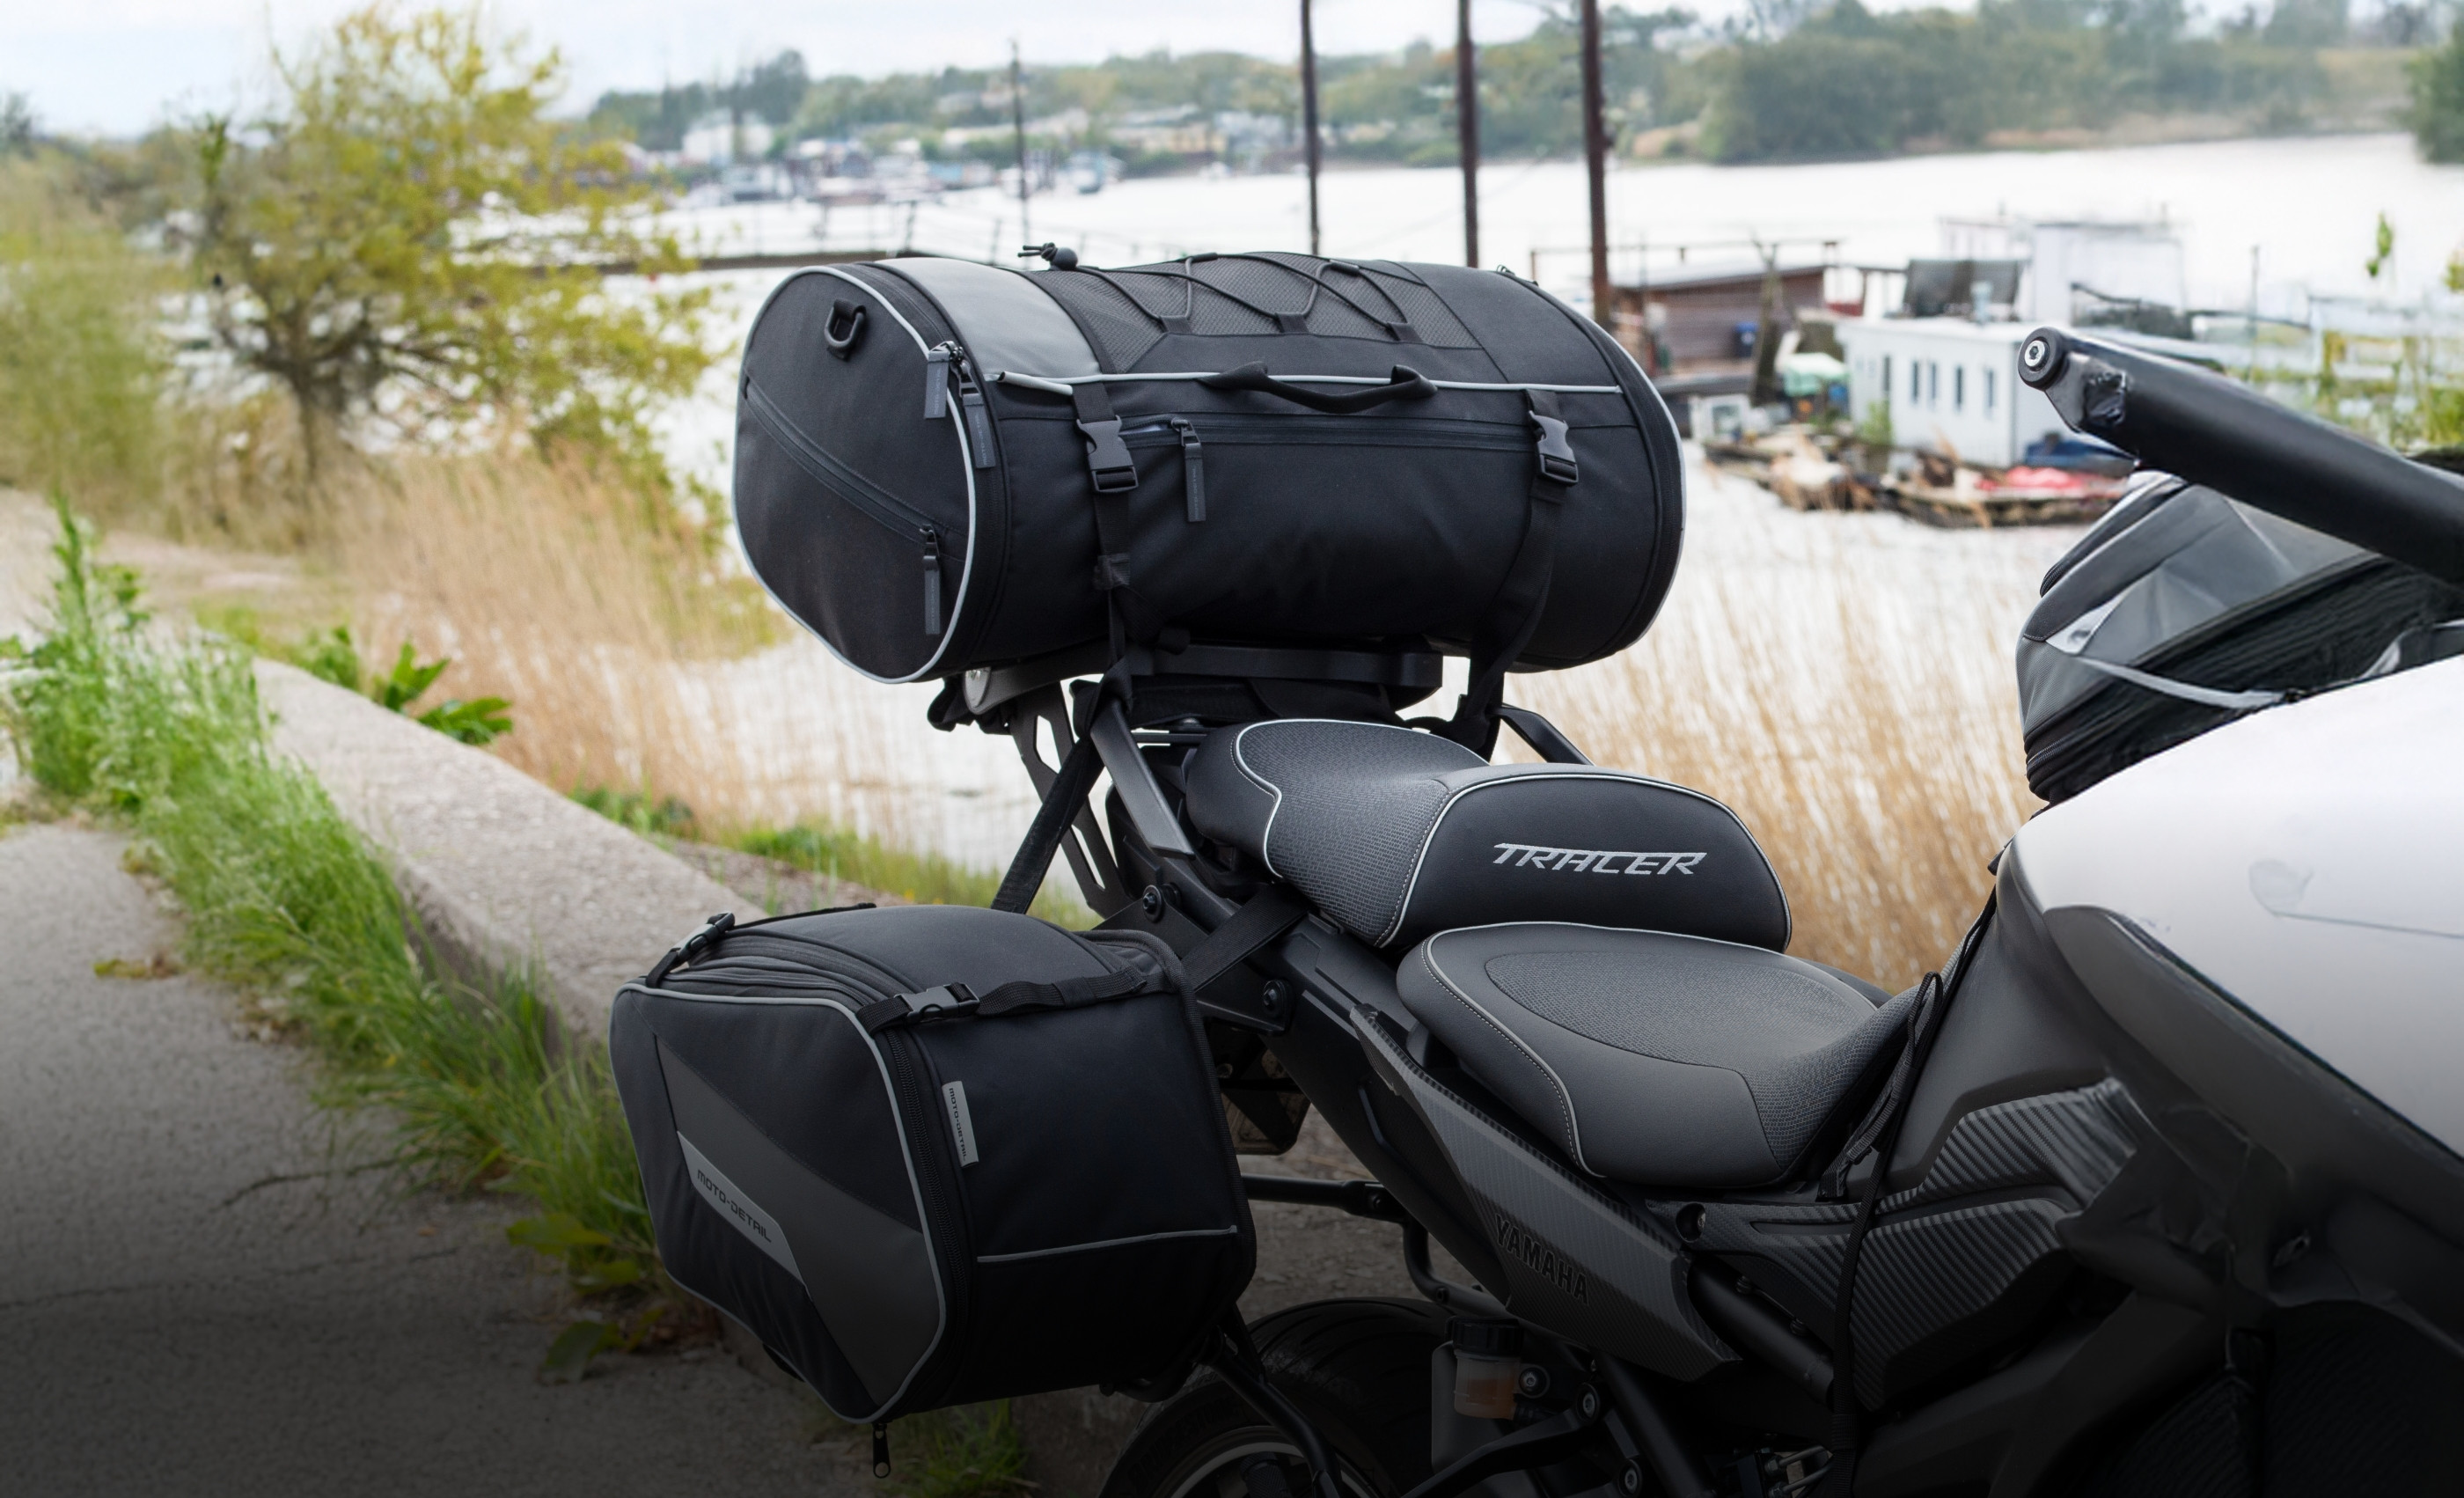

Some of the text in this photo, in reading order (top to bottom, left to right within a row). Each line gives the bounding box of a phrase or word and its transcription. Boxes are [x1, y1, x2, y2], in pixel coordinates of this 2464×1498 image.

[1493, 843, 1707, 875] TRACER
[949, 1087, 967, 1161] MOTO-DETAIL
[697, 1169, 772, 1243] MOTO-DETAIL
[1496, 1214, 1588, 1306] YAMAHA
